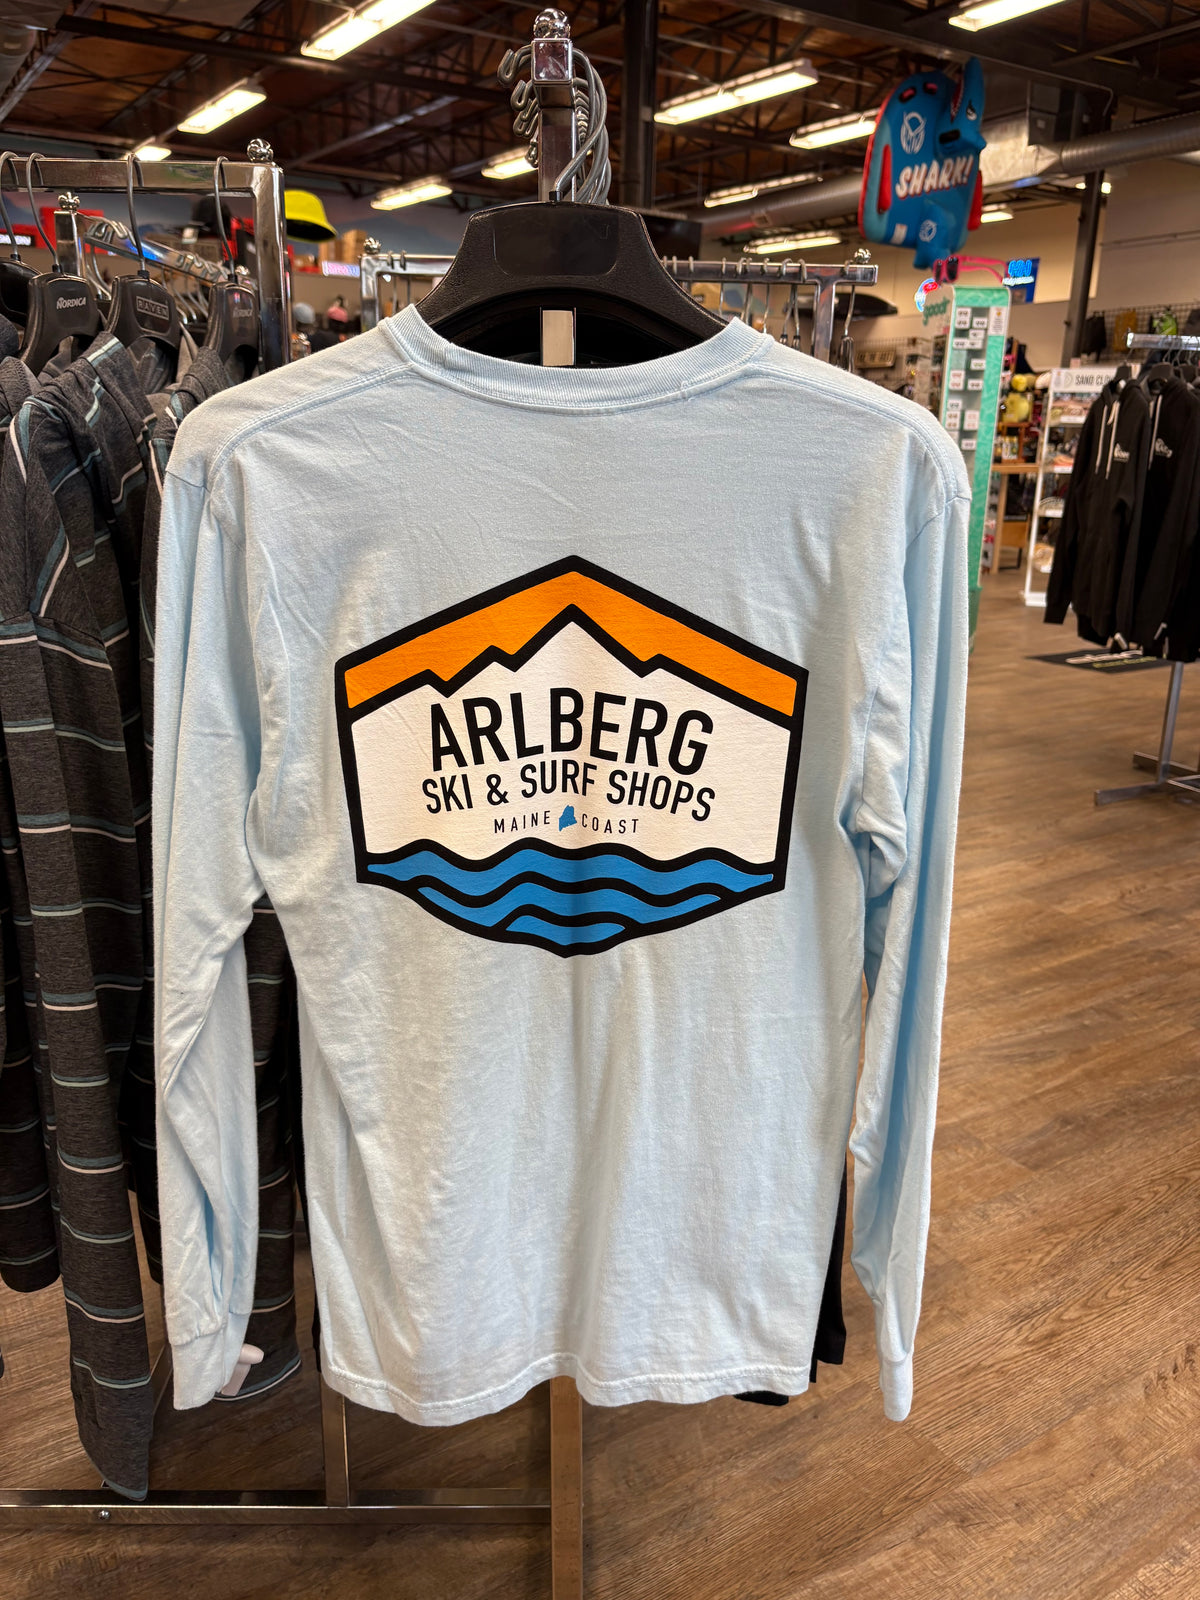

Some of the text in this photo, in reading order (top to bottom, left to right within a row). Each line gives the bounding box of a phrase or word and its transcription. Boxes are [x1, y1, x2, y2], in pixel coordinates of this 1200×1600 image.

[895, 154, 974, 199] SHARK!
[56, 297, 87, 310] NORDICA
[431, 688, 714, 776] ARLBERG
[422, 759, 716, 822] SKI & SURF SHOPS
[494, 810, 639, 834] MAINE COAST
